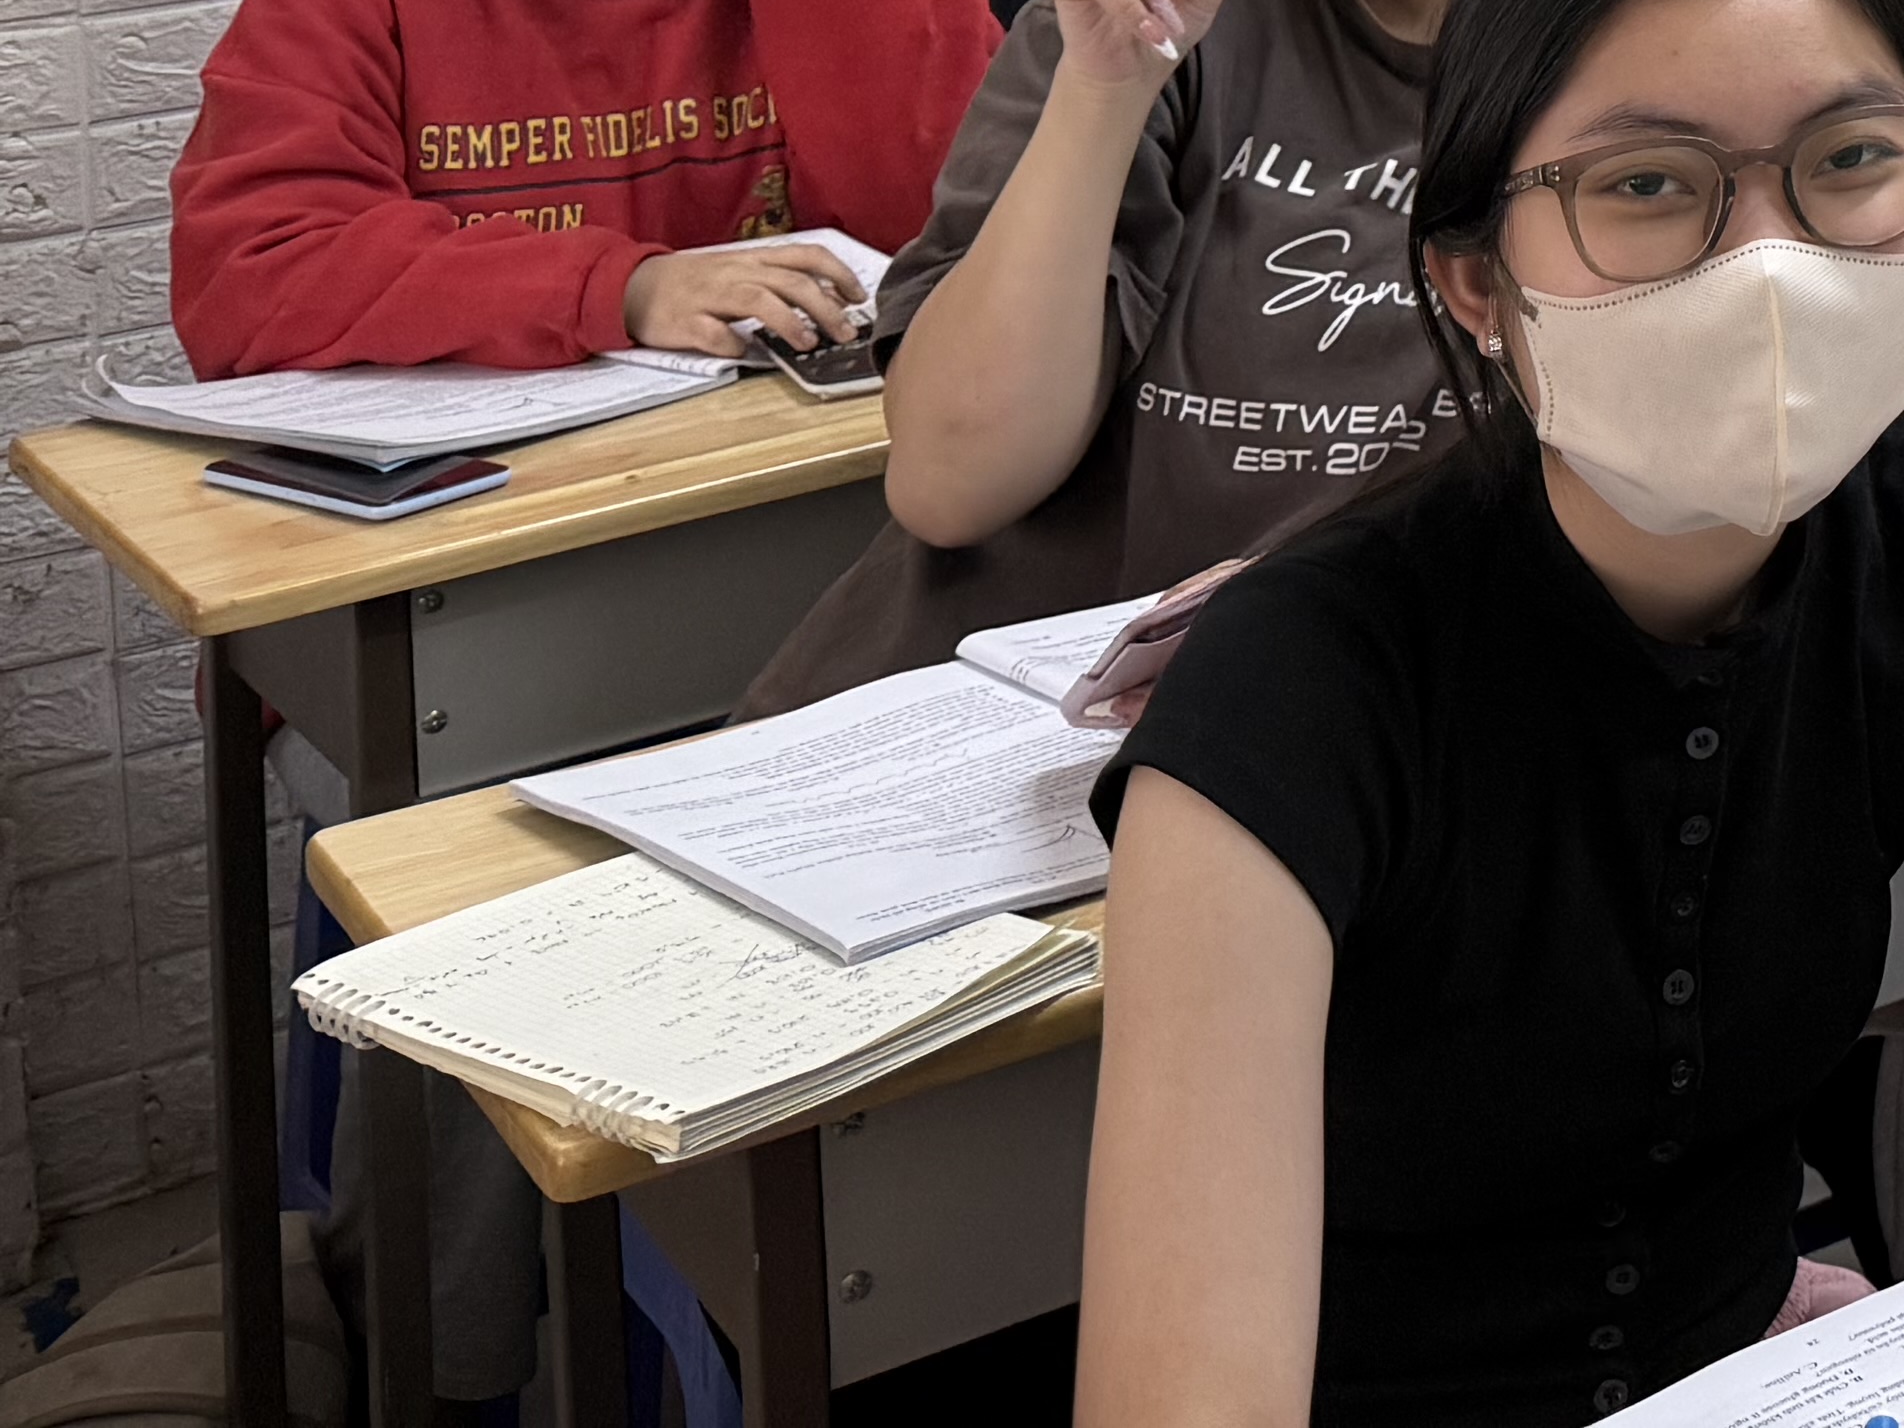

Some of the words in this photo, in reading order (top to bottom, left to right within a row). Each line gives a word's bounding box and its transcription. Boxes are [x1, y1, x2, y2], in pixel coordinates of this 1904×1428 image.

[419, 116, 574, 172] SEMPER
[580, 97, 700, 159] FIDELIS
[1222, 136, 1316, 197] ALL
[1137, 383, 1408, 434] STREETWEA
[1233, 446, 1318, 472] EST.
